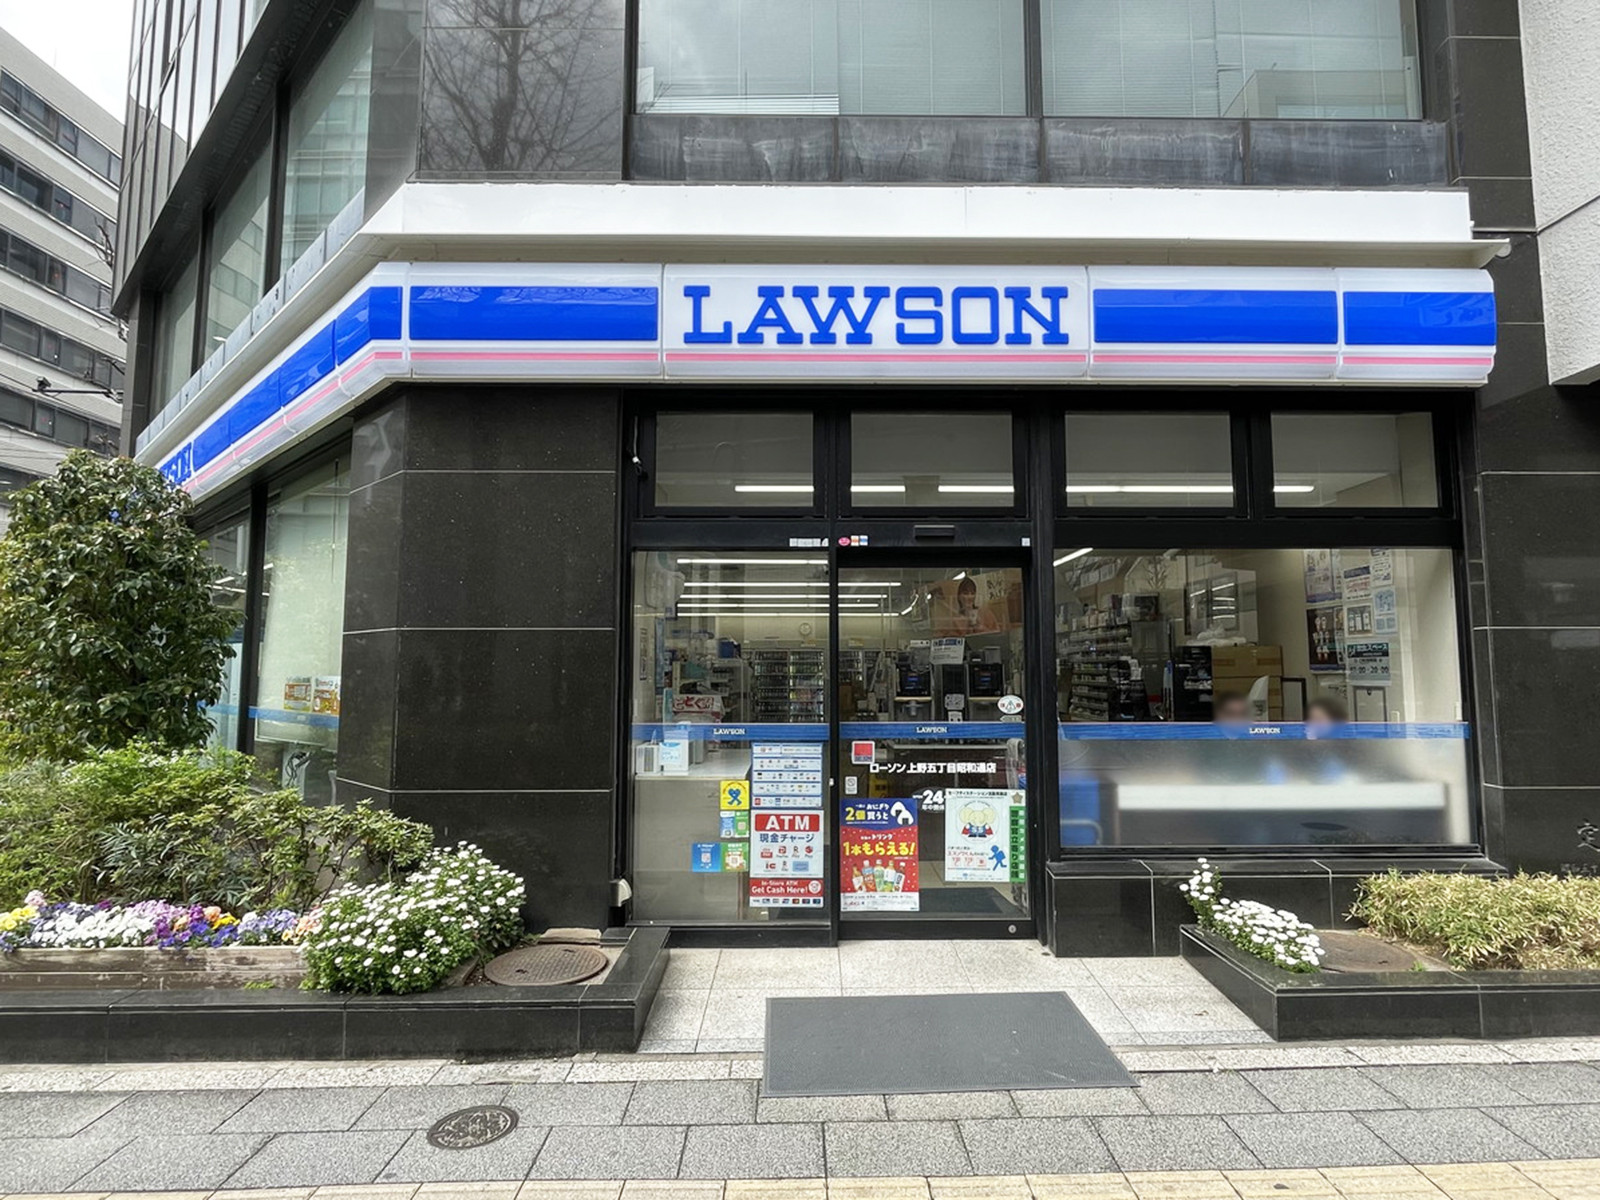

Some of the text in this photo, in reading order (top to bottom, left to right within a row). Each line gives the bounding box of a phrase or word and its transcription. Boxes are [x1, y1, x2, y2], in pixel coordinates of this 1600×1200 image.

[683, 285, 1069, 345] LAWSON
[1249, 727, 1281, 735] LAWSON
[870, 763, 906, 774] ローソン
[765, 815, 810, 830] ATM
[759, 833, 815, 843] 現金チャージ
[751, 886, 765, 894] Get
[766, 886, 785, 894] Cash
